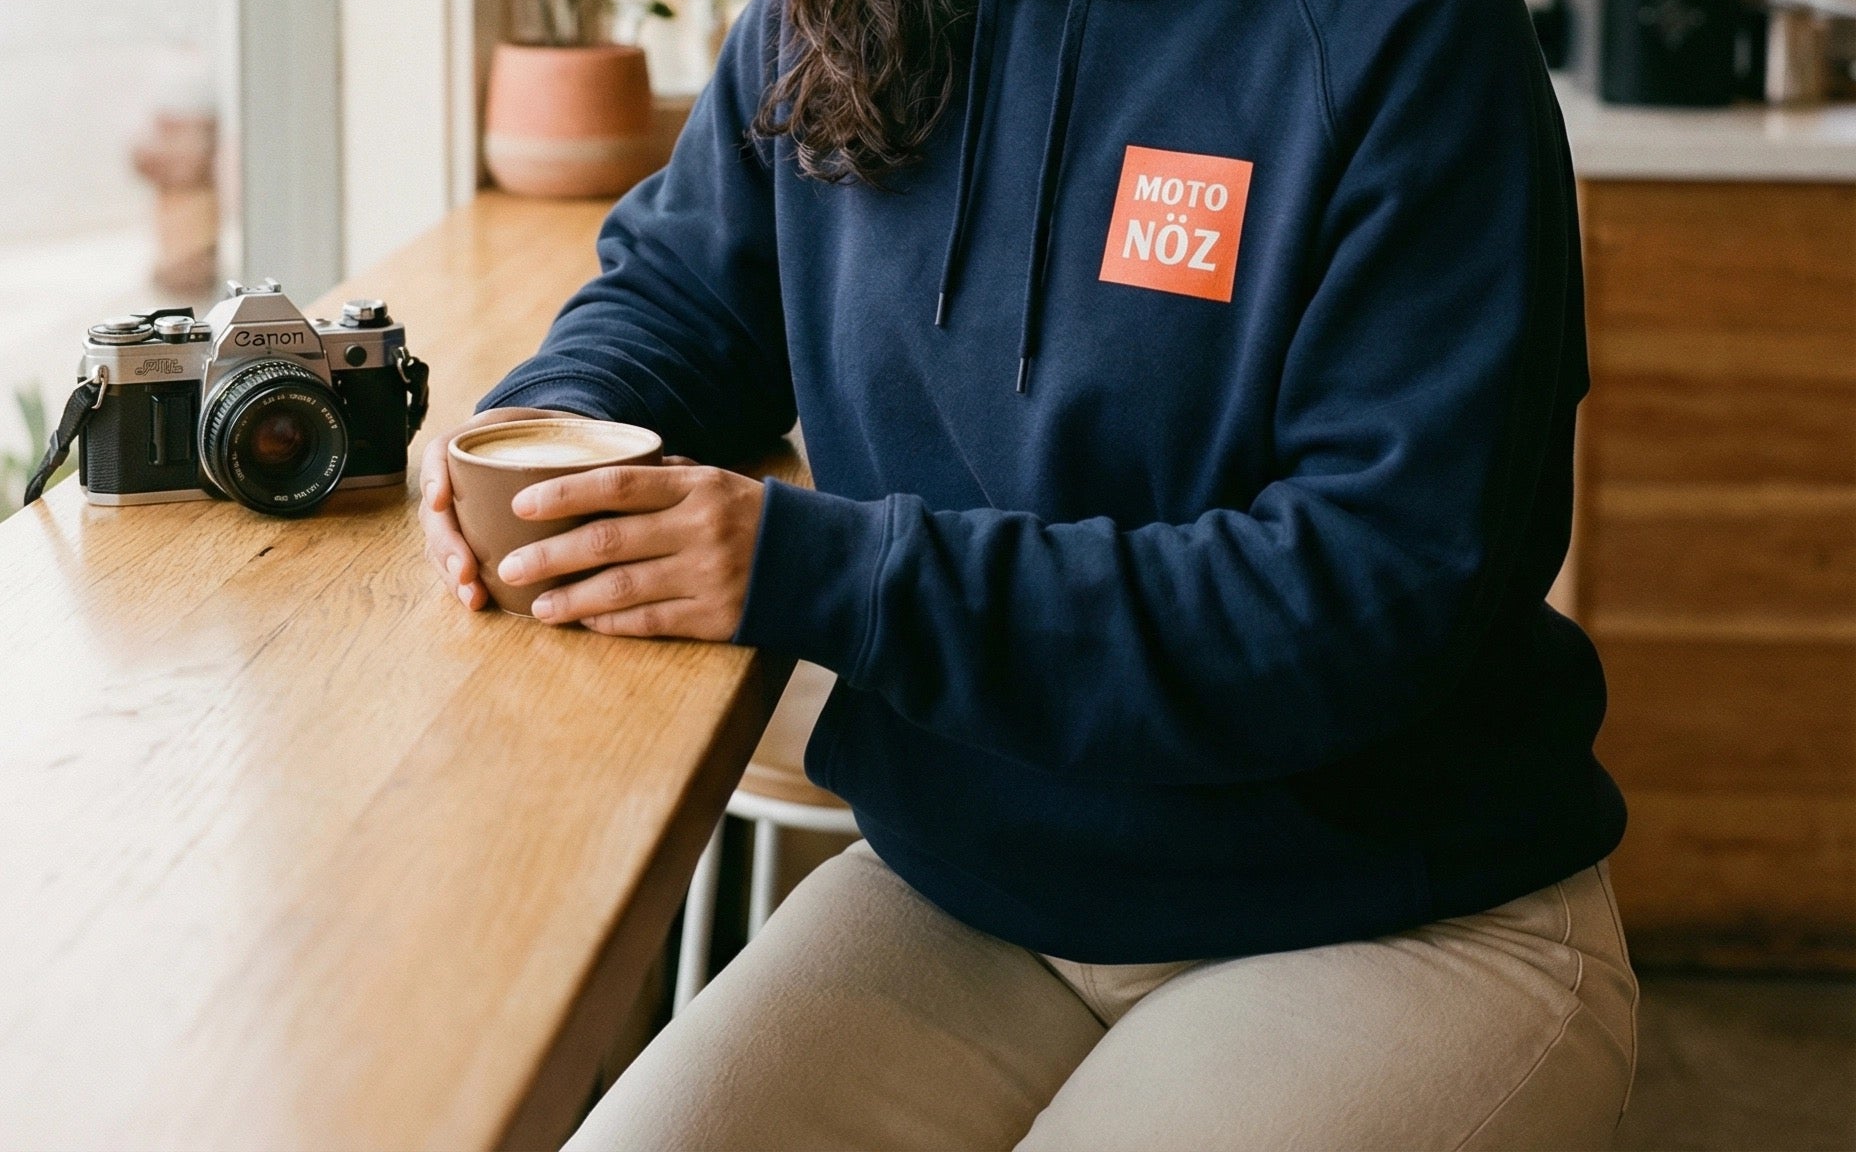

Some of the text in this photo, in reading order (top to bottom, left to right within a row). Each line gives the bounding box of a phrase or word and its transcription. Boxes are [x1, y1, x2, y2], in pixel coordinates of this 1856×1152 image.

[1133, 174, 1228, 212] MOTO
[1122, 212, 1220, 272] NÖZ
[234, 330, 304, 348] Canon
